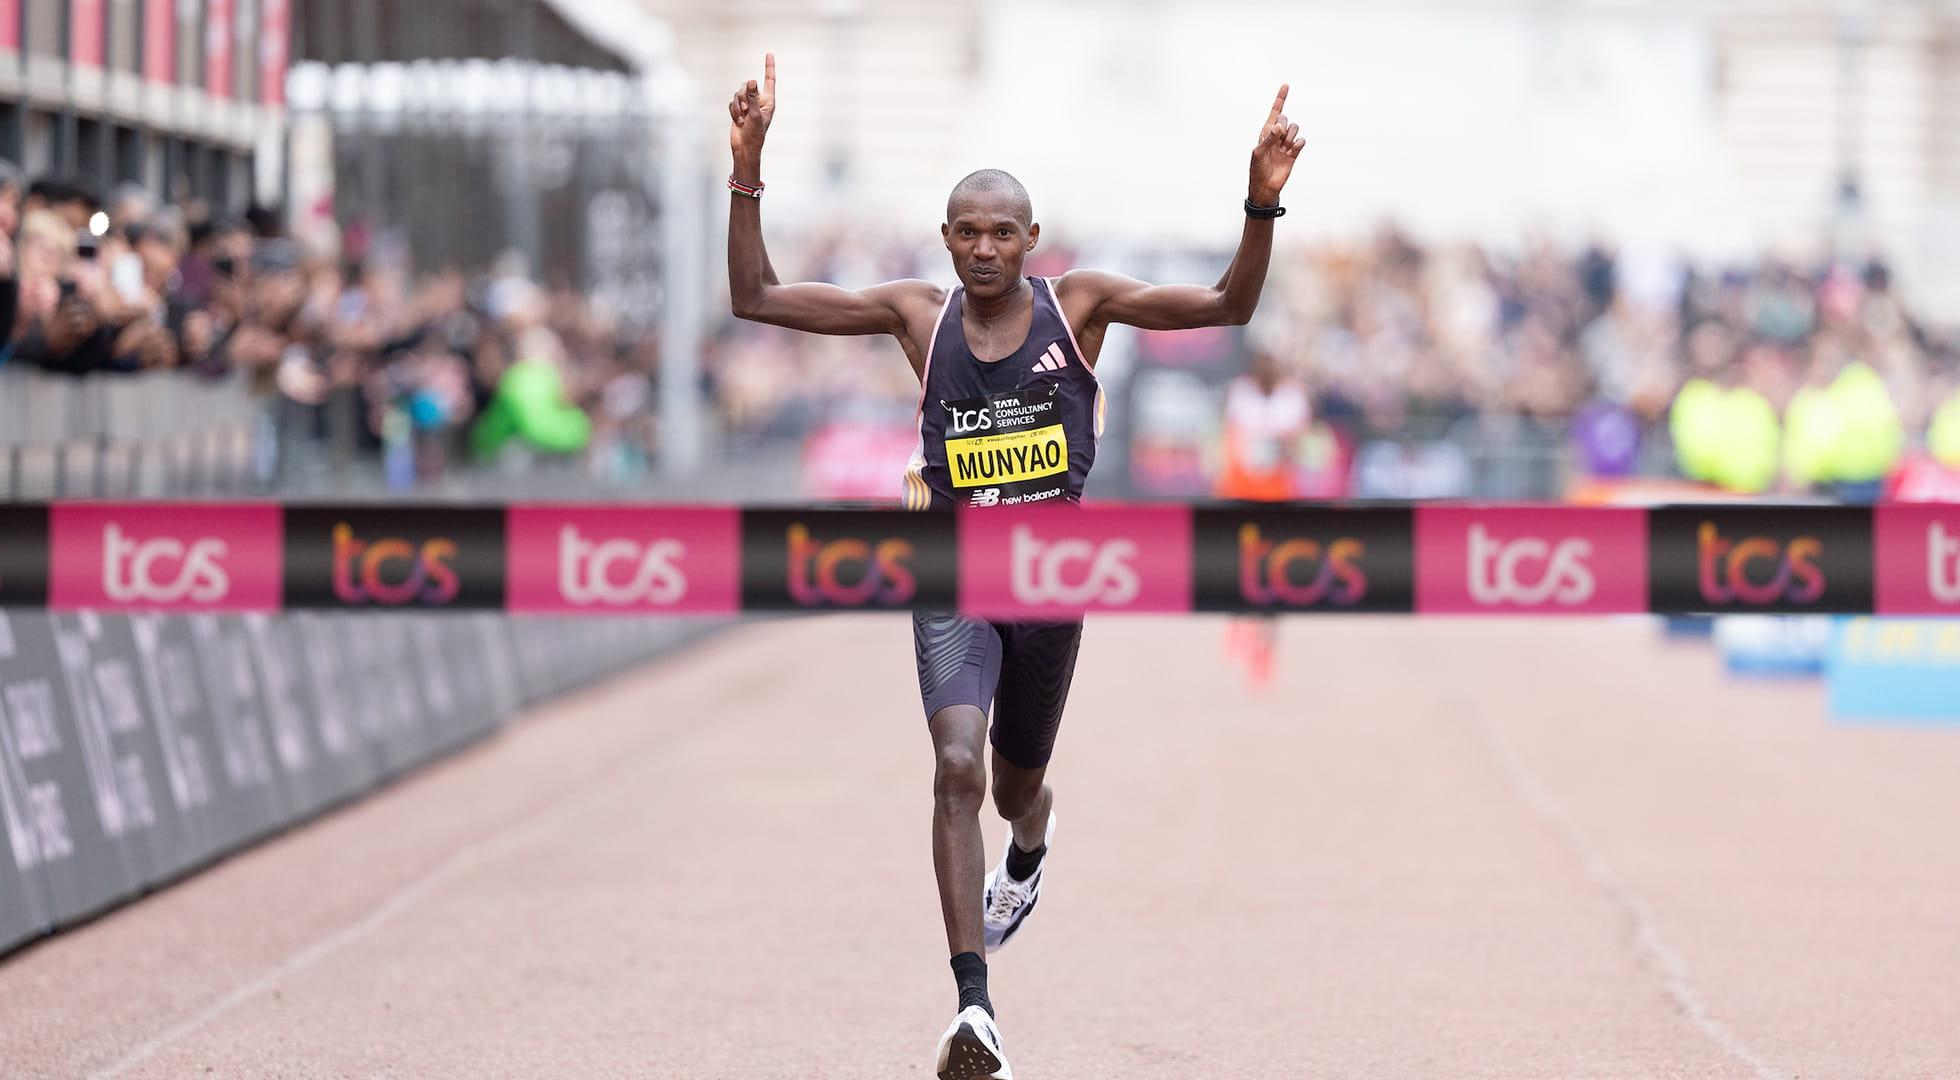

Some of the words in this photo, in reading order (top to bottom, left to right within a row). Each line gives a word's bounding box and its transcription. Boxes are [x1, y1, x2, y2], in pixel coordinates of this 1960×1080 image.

[952, 406, 992, 432] tcs
[993, 398, 1020, 409] TATA
[995, 401, 1053, 418] CONSULTANCY
[996, 415, 1035, 428] SERVICES
[956, 439, 1061, 481] MUNYAO
[1001, 496, 1022, 506] new
[1023, 487, 1061, 503] balance
[102, 523, 229, 602] tcs
[332, 522, 460, 602] tcs
[558, 524, 687, 604] tcs
[787, 523, 916, 604] tcs
[1009, 524, 1140, 604] tcs
[1238, 523, 1367, 604] tcs
[1465, 523, 1596, 604] tcs
[1697, 521, 1826, 603] tcs
